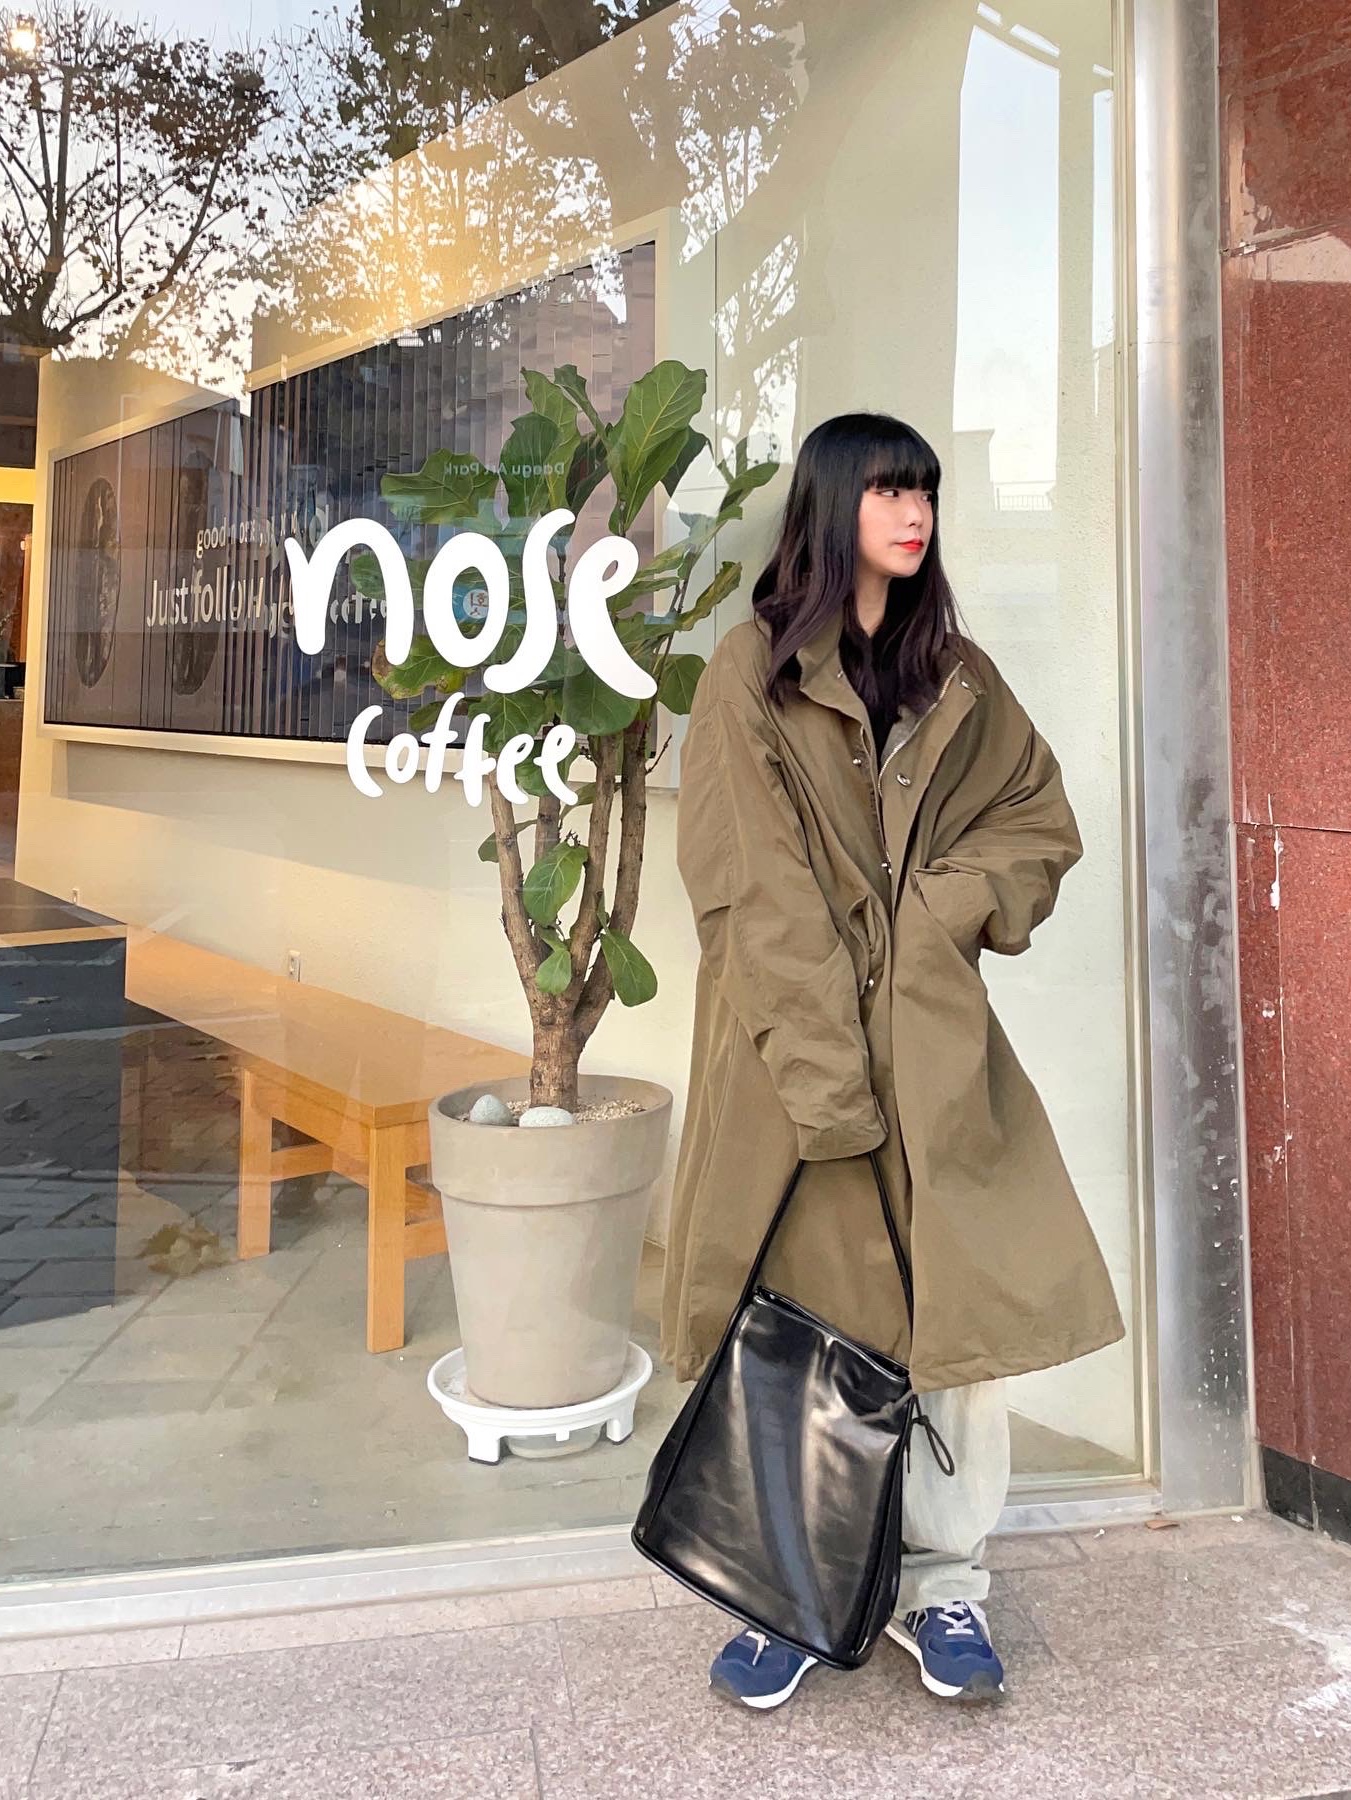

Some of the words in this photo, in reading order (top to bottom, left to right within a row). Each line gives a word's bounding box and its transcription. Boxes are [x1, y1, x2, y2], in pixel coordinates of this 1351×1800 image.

[196, 517, 228, 559] good
[147, 577, 188, 627] Just
[284, 508, 658, 699] nose
